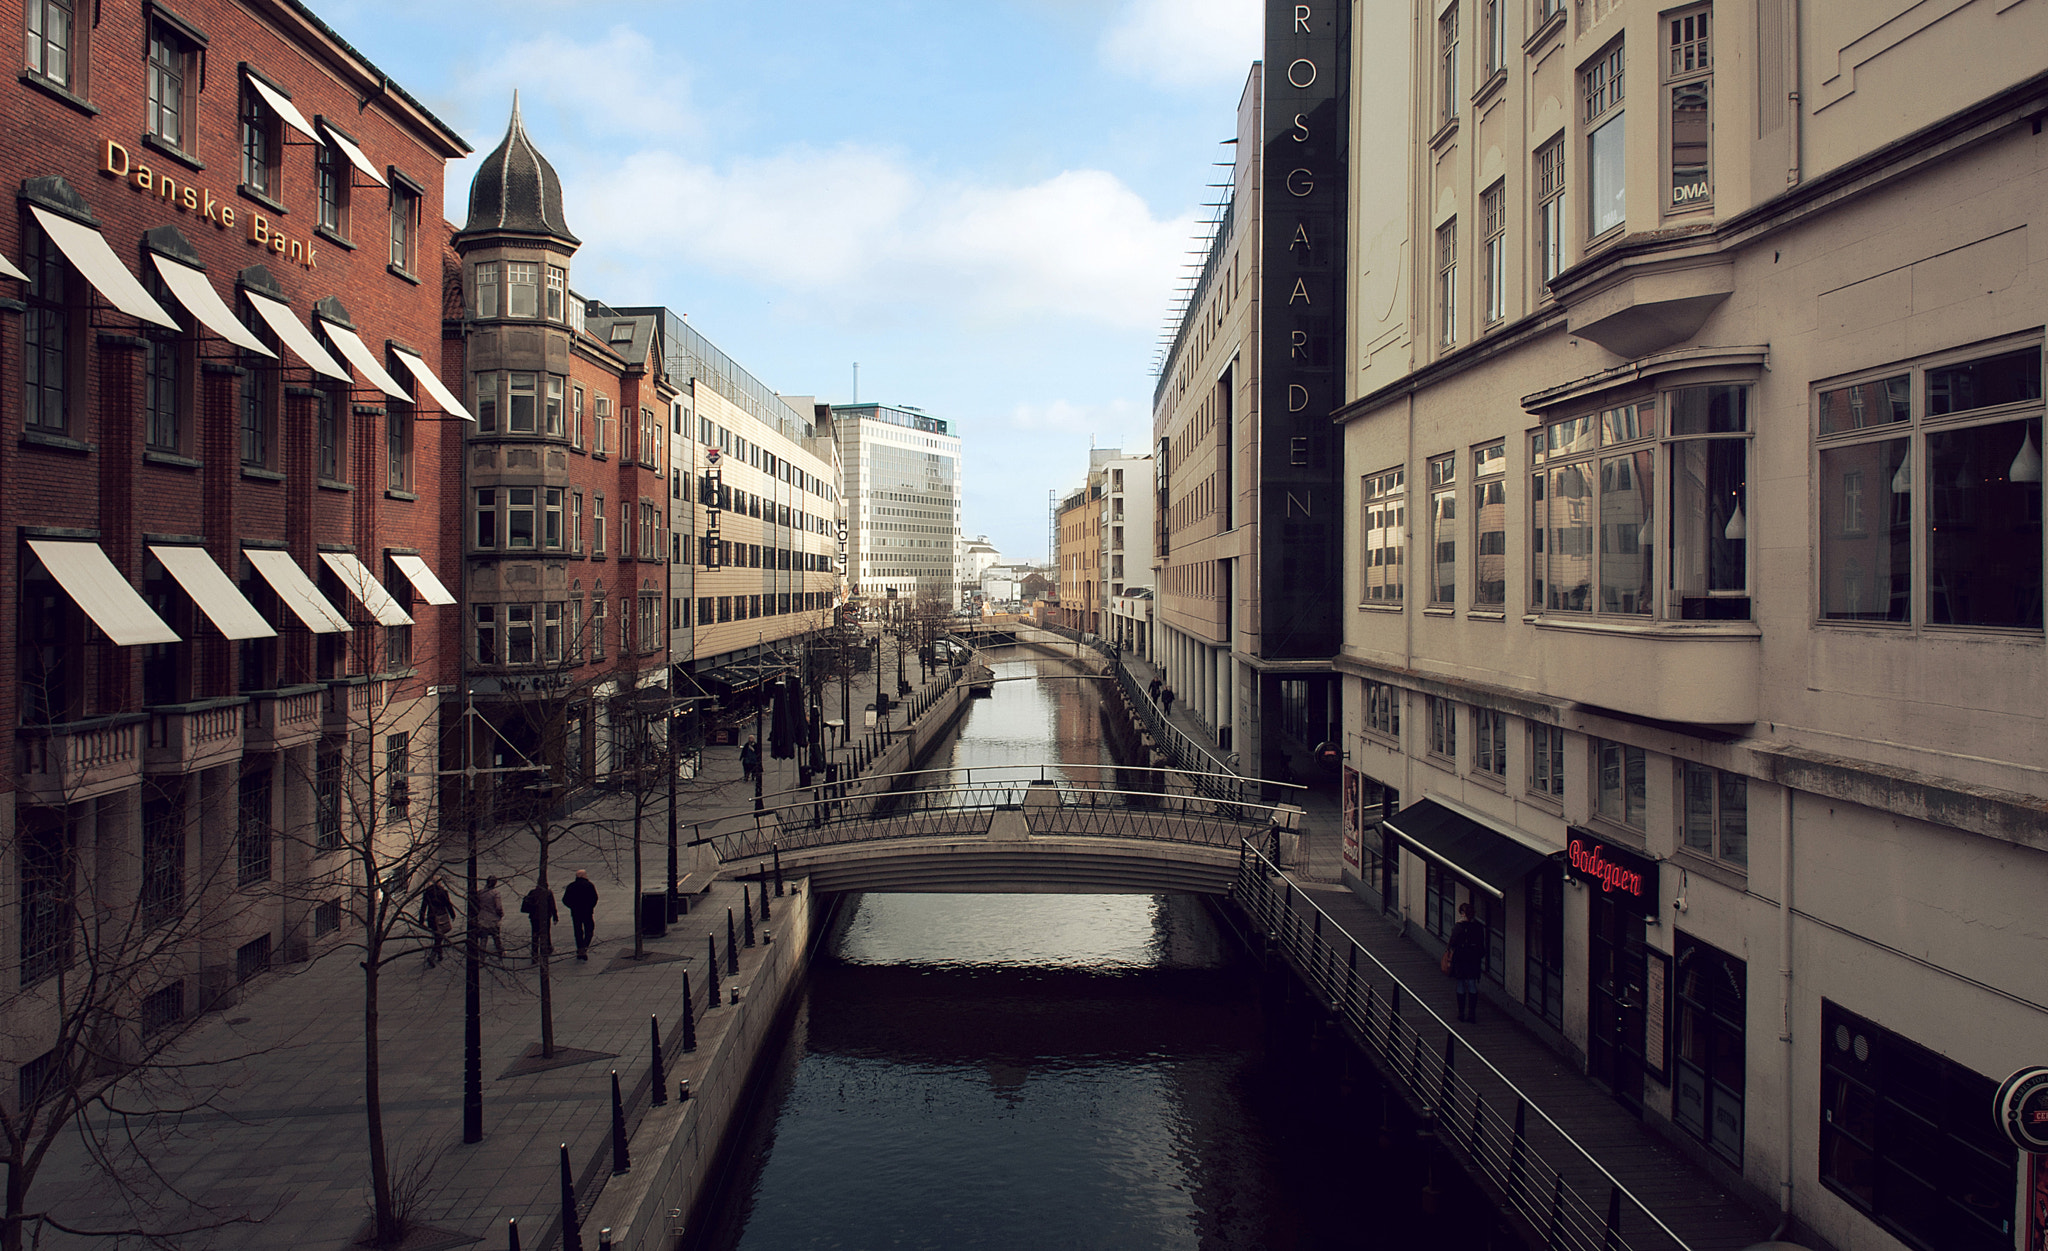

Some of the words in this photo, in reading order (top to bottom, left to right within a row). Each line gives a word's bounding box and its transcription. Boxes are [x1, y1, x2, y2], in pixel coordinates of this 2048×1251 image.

[105, 139, 235, 228] Danske
[252, 211, 318, 268] Bank
[1673, 182, 1709, 202] DMA
[705, 469, 723, 568] HOTEL
[1568, 839, 1643, 897] Bodegaen
[2013, 1081, 2032, 1102] CERES
